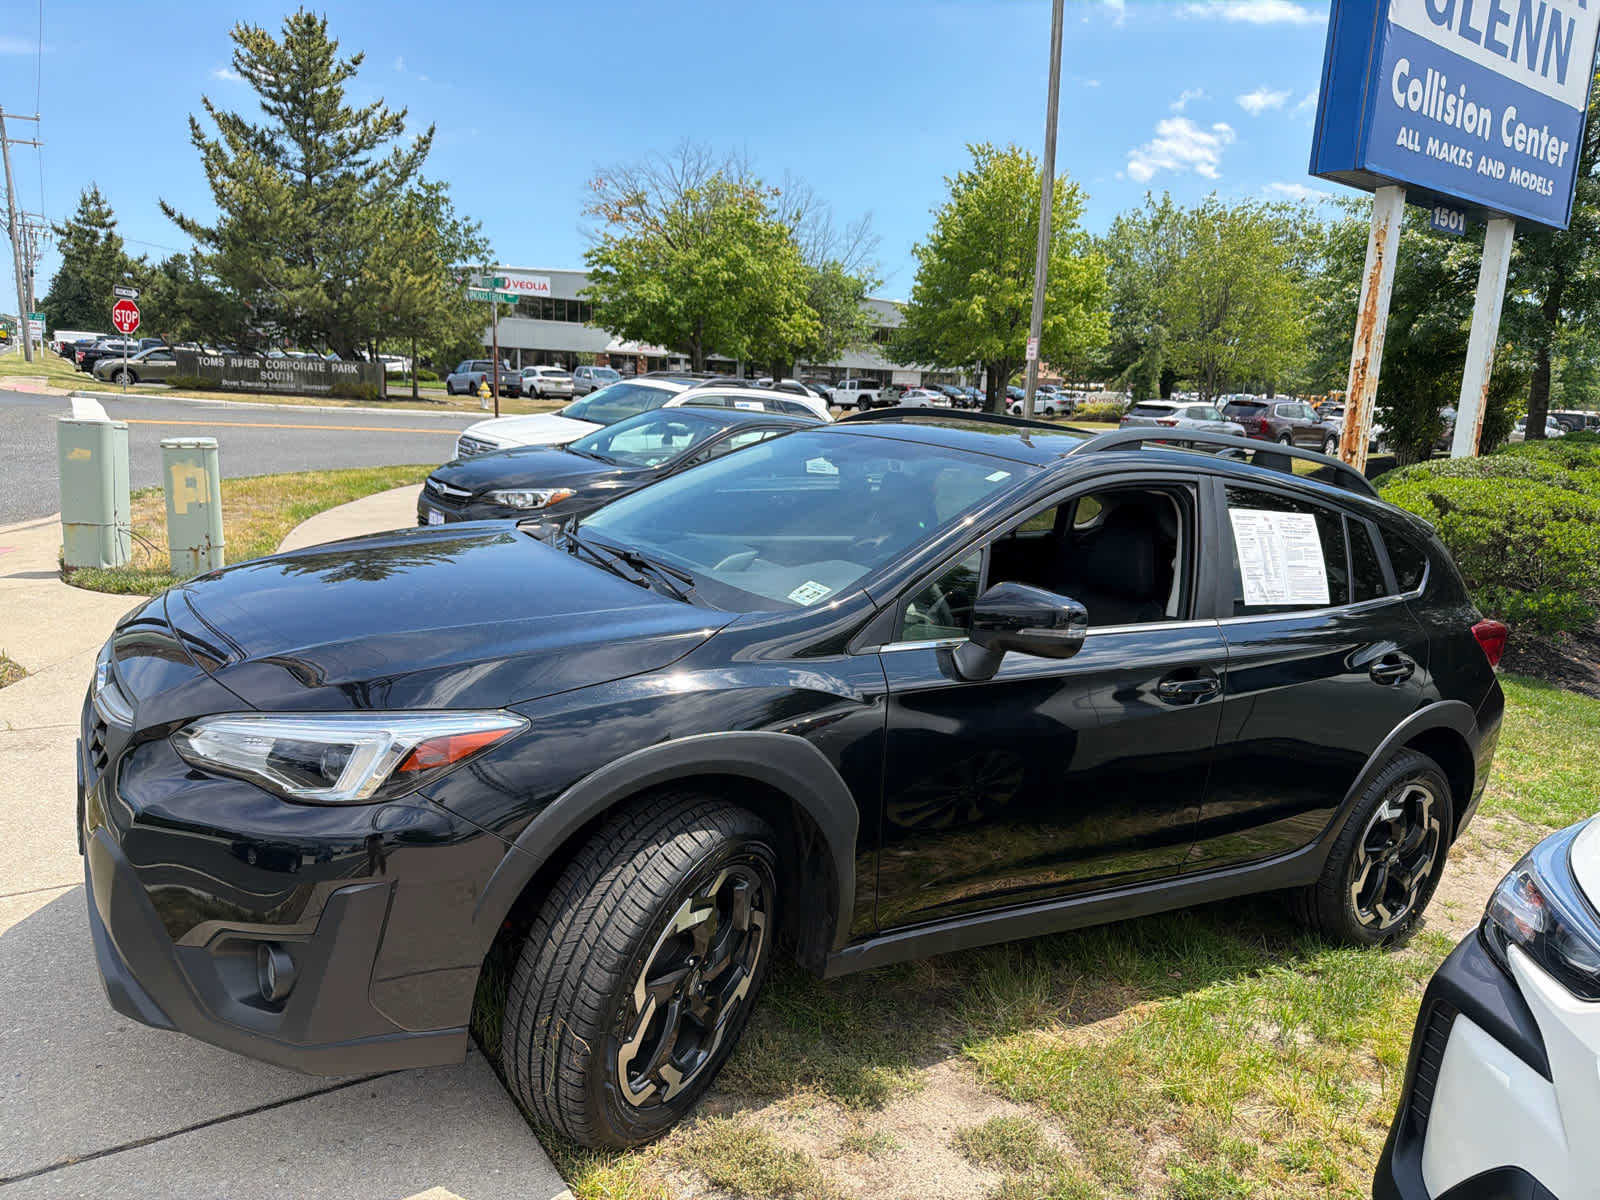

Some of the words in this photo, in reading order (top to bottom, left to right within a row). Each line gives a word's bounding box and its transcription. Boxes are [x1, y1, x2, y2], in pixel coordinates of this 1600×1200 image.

[1391, 57, 1492, 142] Collision
[1501, 105, 1569, 168] Center
[1396, 126, 1421, 153] ALL
[1425, 136, 1473, 169] MAKES
[1477, 155, 1505, 180] AND
[1508, 166, 1554, 197] MODELS
[1433, 205, 1466, 232] 1501
[512, 280, 549, 291] VEOLIA
[115, 309, 138, 324] STOP
[198, 356, 225, 367] TOMS
[231, 357, 260, 369] RIVER
[265, 359, 326, 373] CORPORATE
[331, 362, 359, 375] PARK
[260, 371, 294, 382] SOUTH
